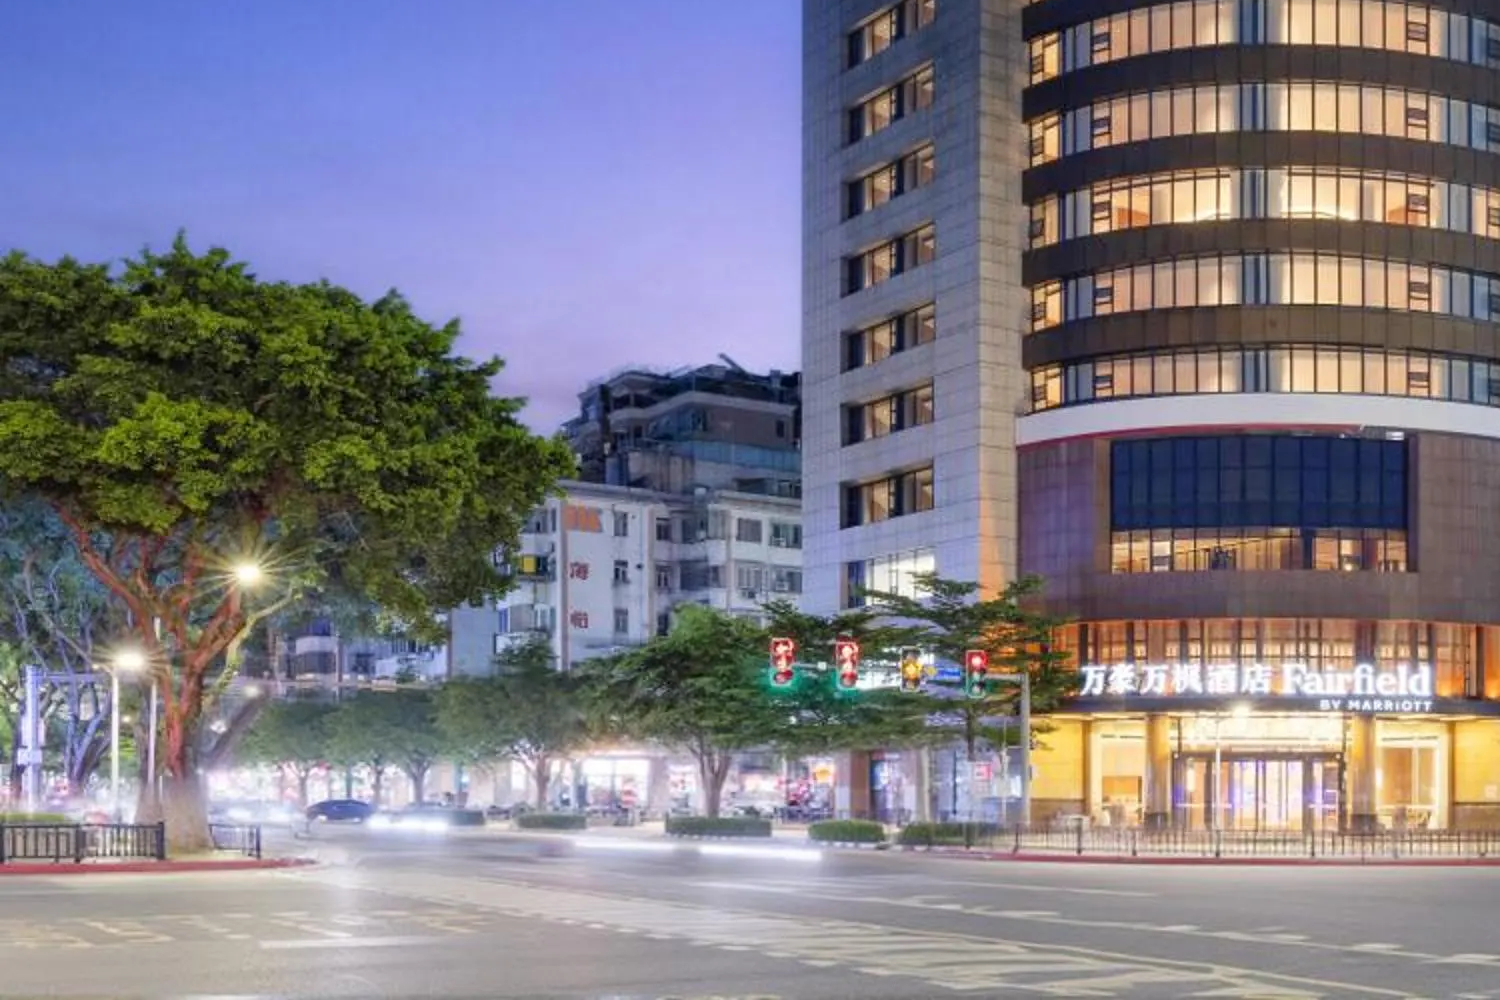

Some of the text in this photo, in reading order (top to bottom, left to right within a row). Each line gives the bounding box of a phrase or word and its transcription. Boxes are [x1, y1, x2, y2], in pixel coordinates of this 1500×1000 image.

[1079, 661, 1434, 697] 万豪万枫酒店 Fairfield
[1319, 699, 1434, 713] BY MARRIOTT
